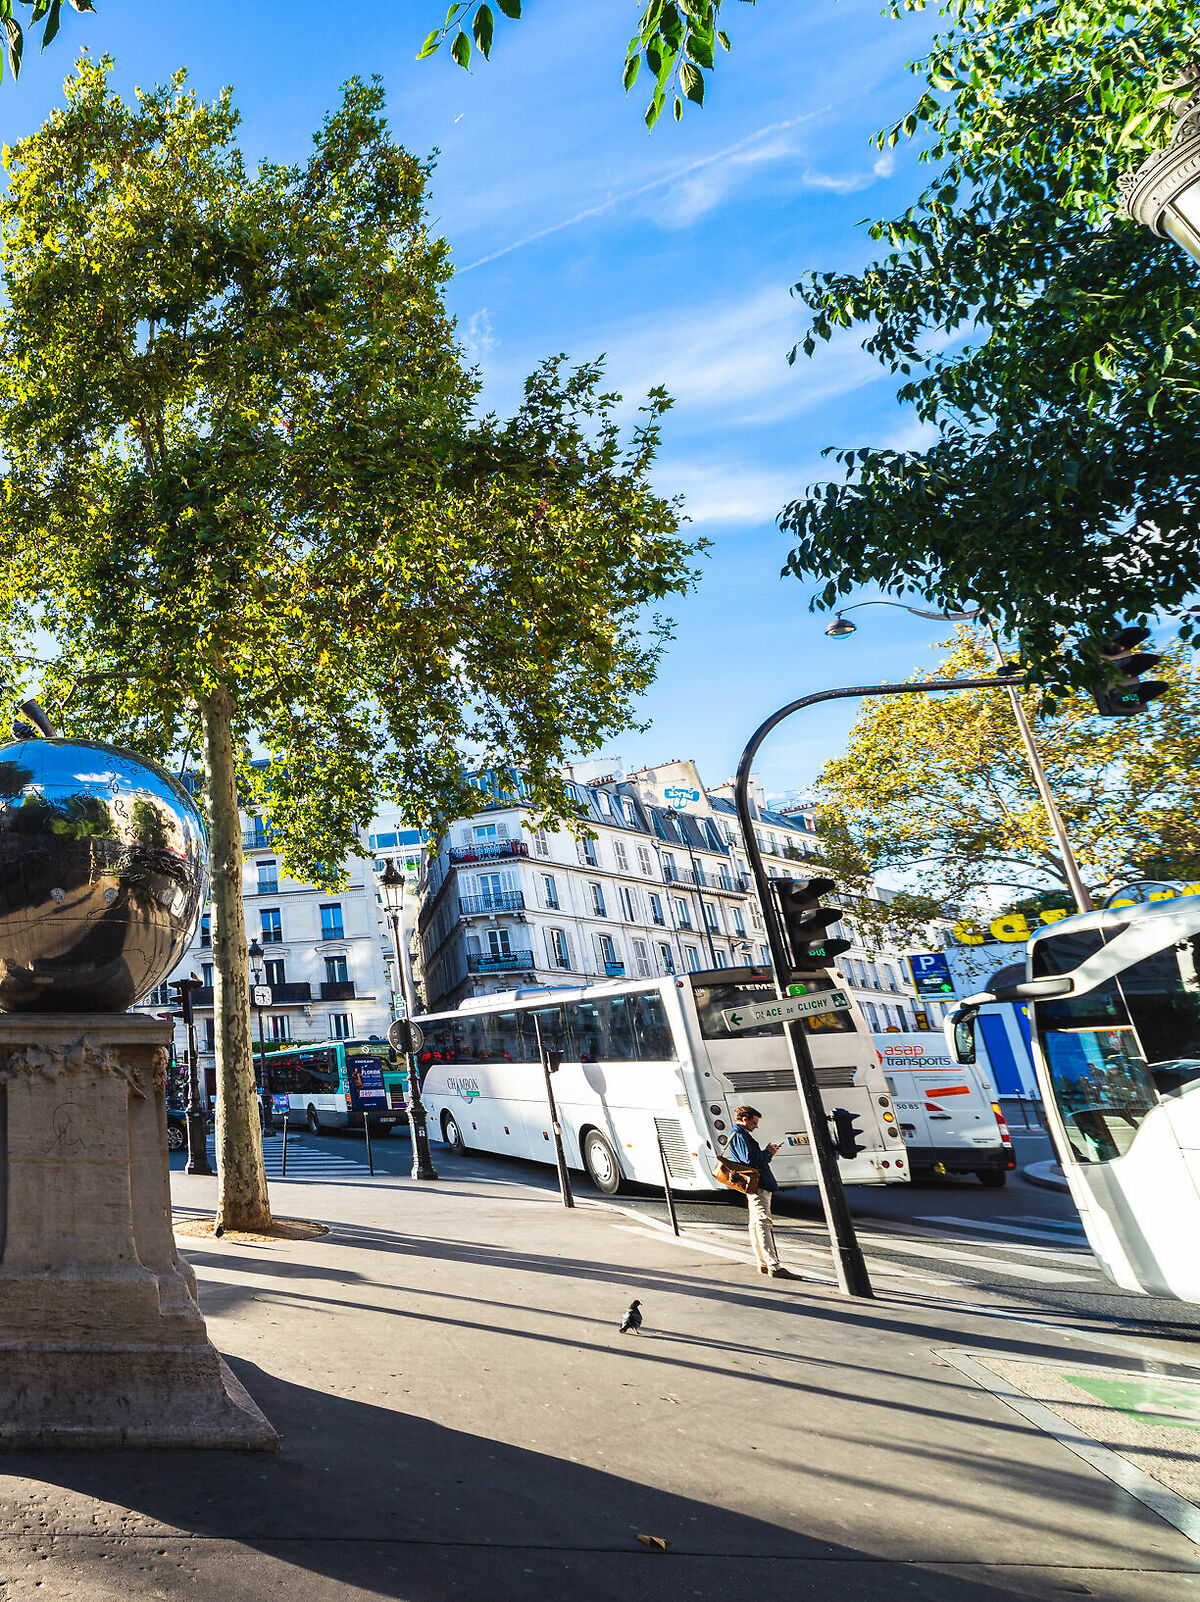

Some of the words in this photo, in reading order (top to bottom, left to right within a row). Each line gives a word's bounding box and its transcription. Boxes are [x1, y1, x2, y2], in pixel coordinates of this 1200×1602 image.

[919, 956, 935, 971] P
[735, 983, 776, 991] TEMS
[755, 1007, 783, 1019] PLACE
[797, 998, 828, 1012] CLICHY
[884, 1045, 924, 1057] asap
[886, 1057, 951, 1067] transports
